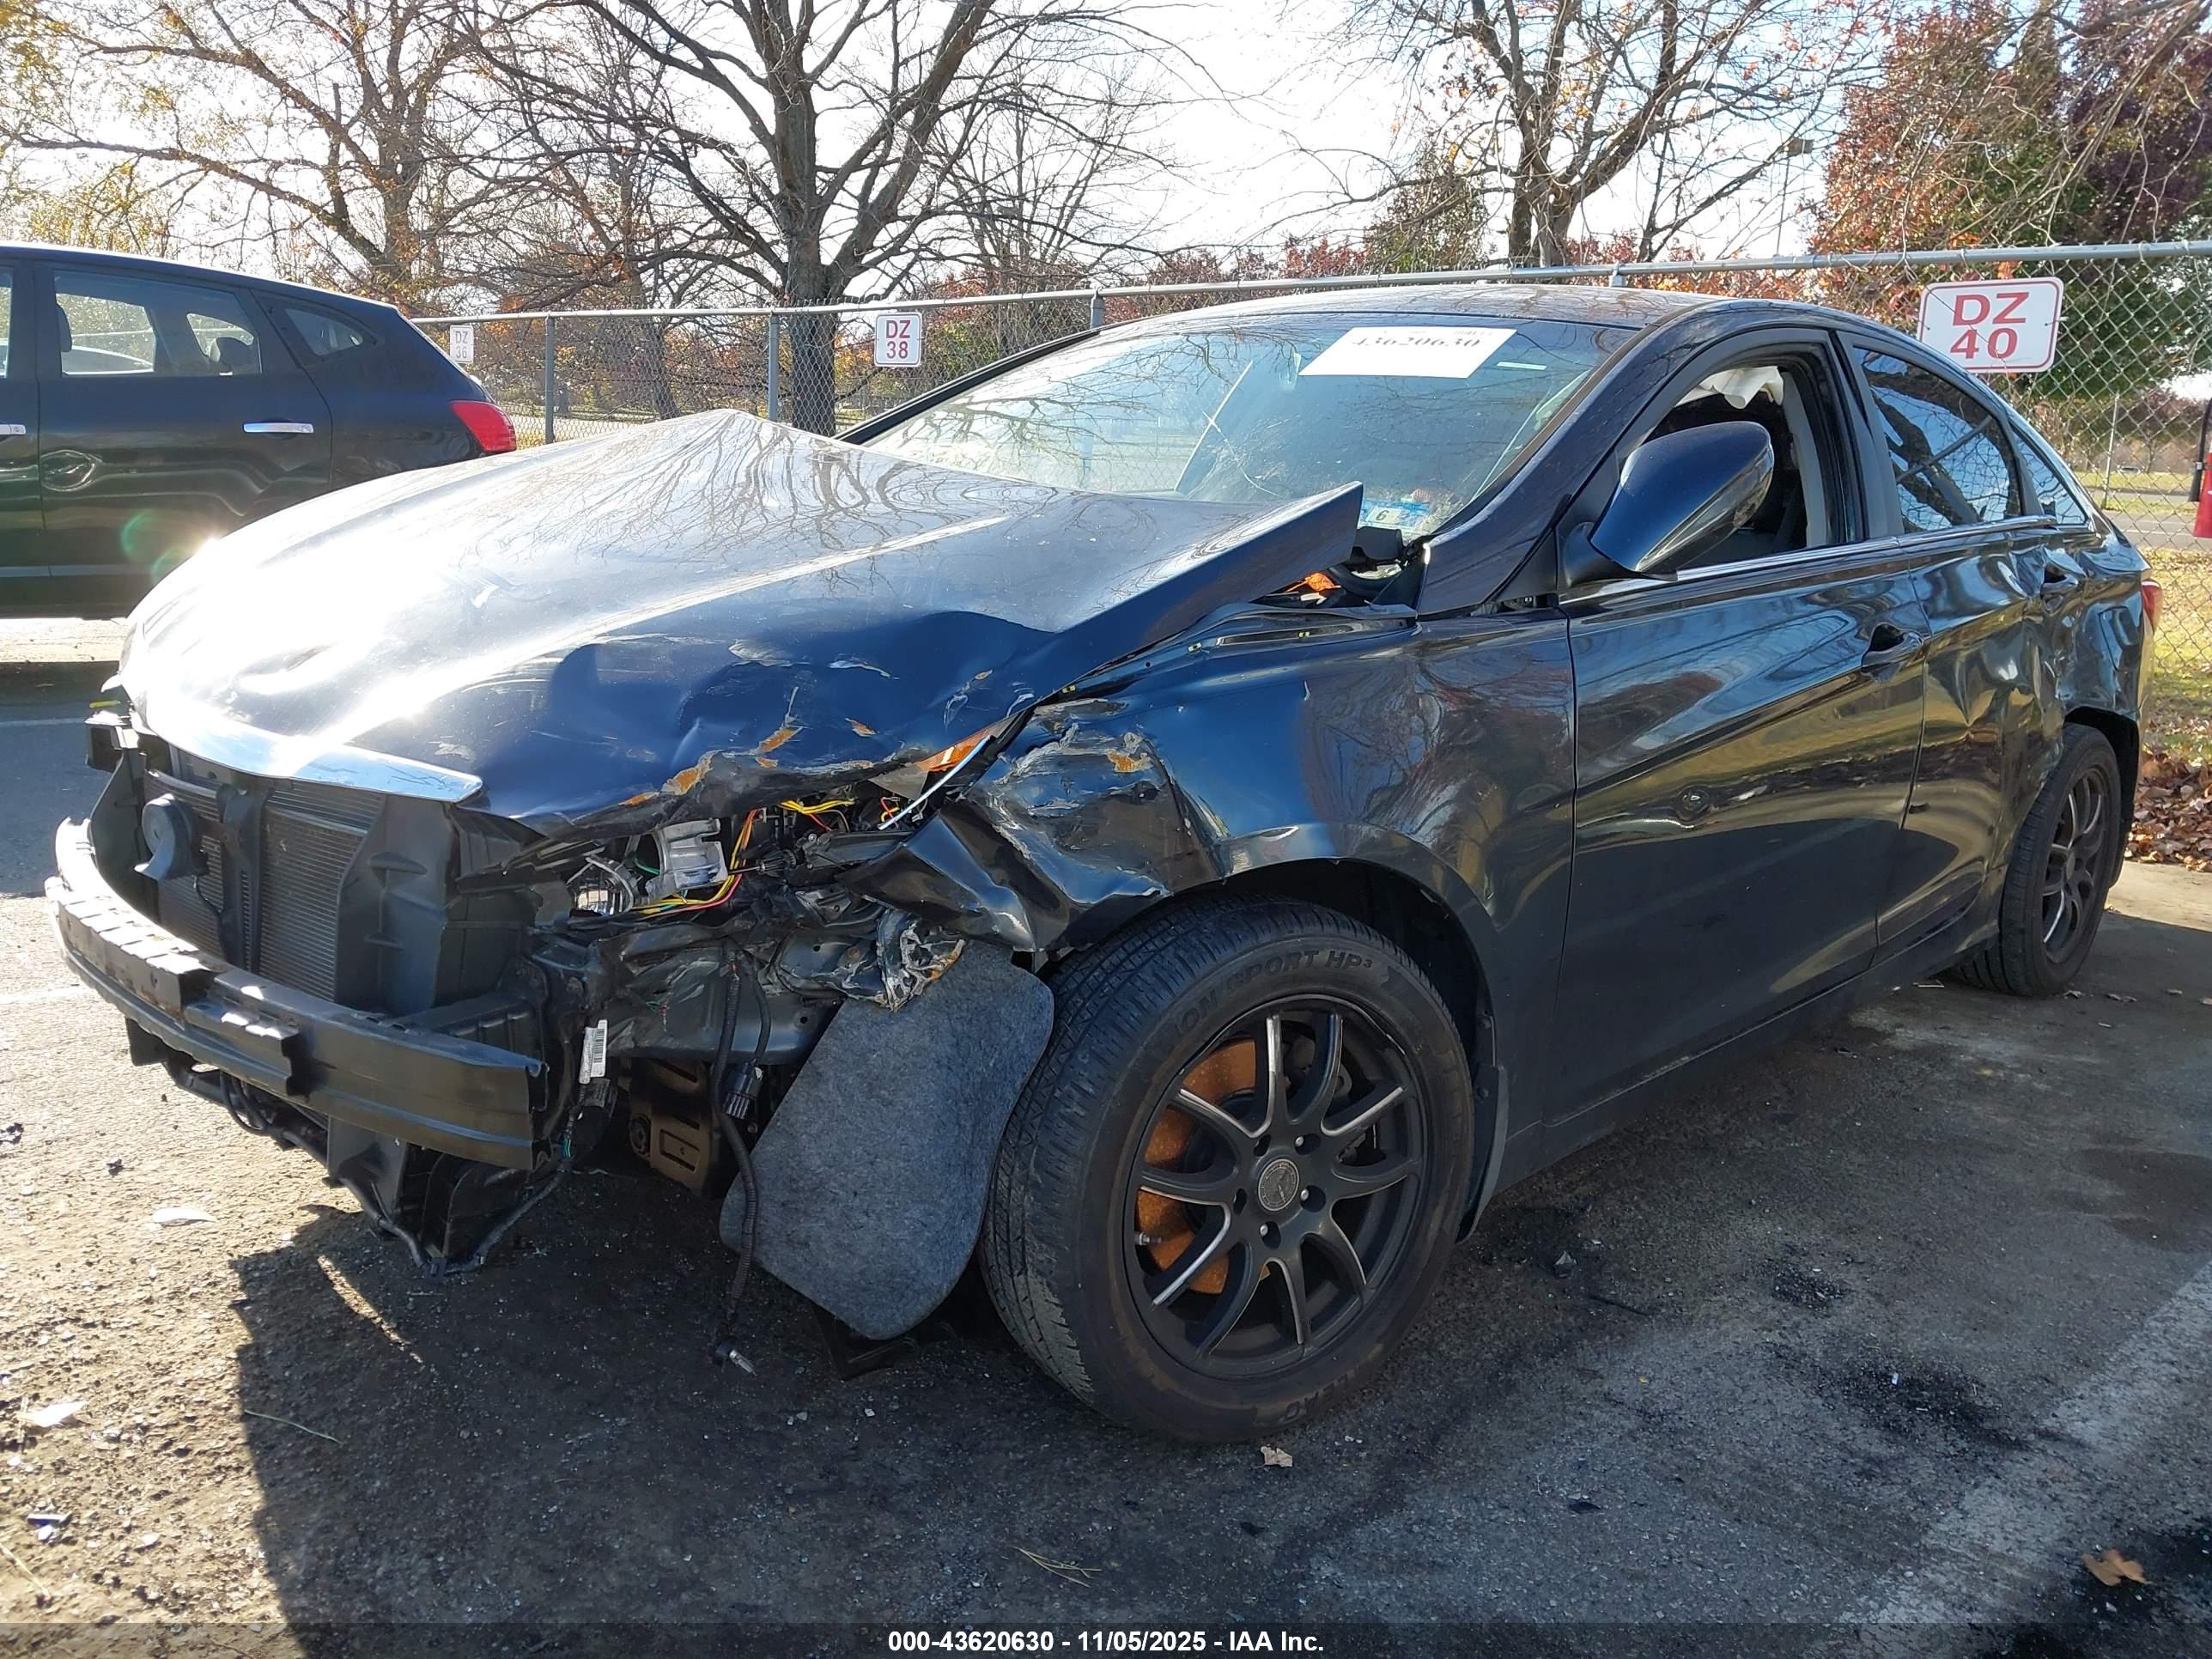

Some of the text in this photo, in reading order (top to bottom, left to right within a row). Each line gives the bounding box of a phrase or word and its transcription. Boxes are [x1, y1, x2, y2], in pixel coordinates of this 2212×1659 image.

[1952, 291, 2030, 326] DZ
[455, 331, 469, 344] DZ
[885, 319, 911, 339] DZ
[455, 345, 468, 359] 36
[886, 340, 908, 359] 38
[1949, 327, 2018, 360] 40
